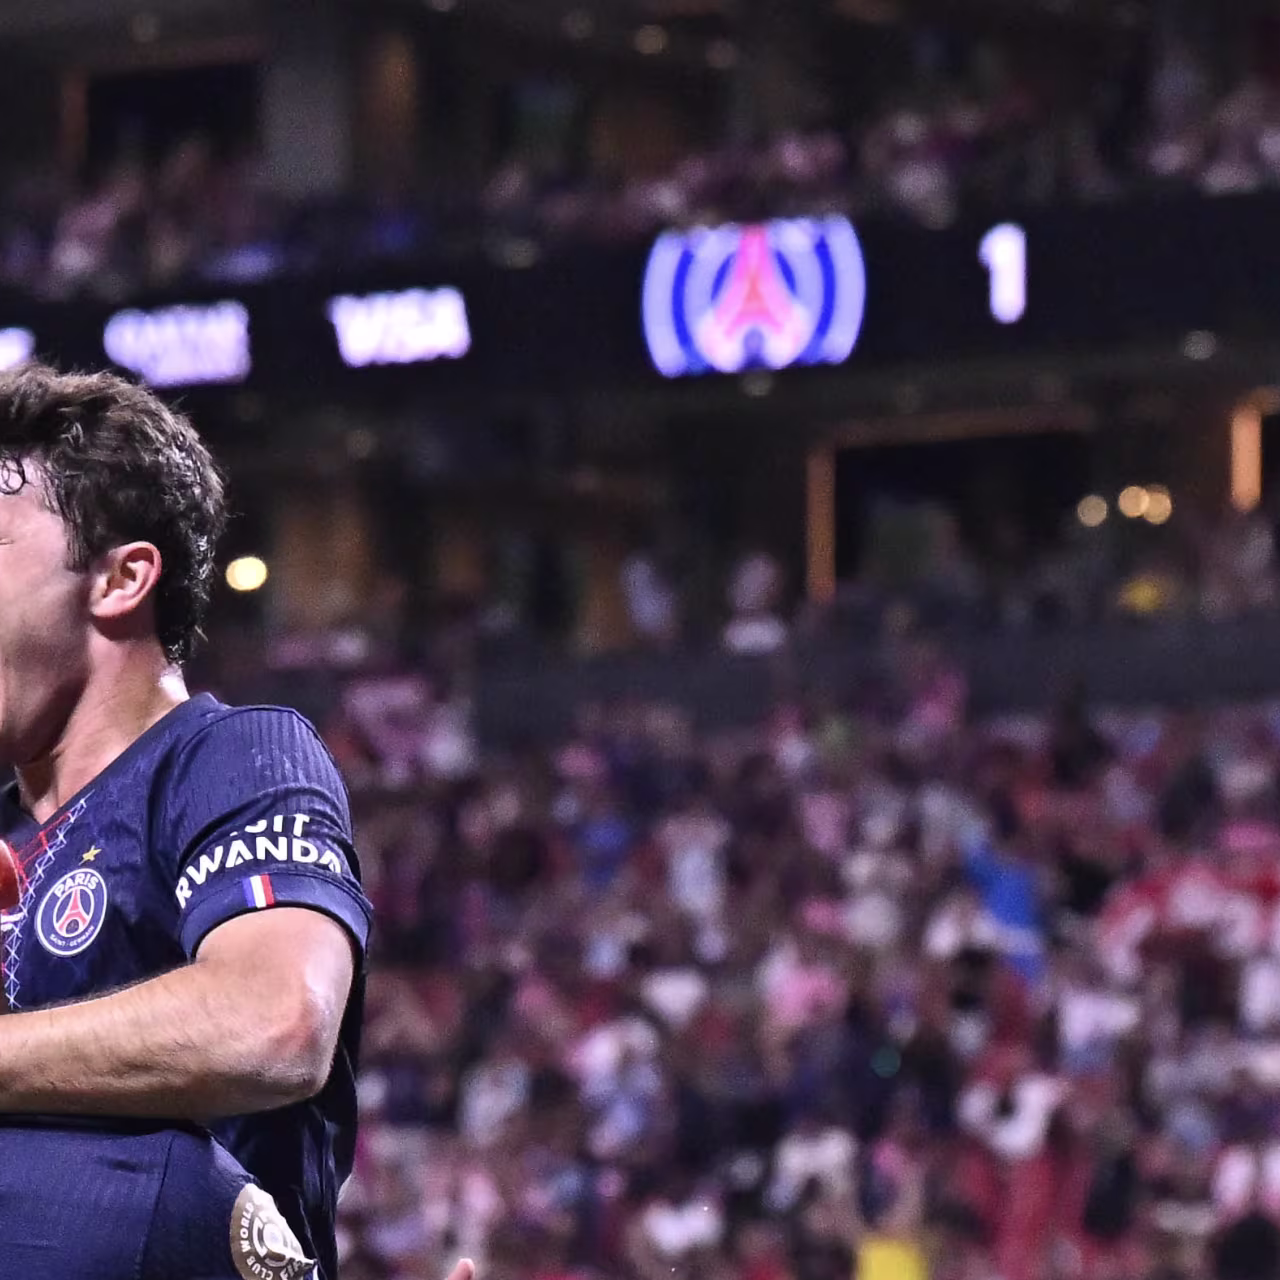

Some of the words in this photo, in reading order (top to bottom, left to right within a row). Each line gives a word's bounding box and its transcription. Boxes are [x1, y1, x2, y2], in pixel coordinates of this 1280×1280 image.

[978, 222, 1028, 325] 1
[53, 873, 99, 898] PARIS
[175, 836, 342, 909] RWANDA
[239, 1202, 255, 1252] WORLD
[246, 1255, 274, 1280] CLUB
